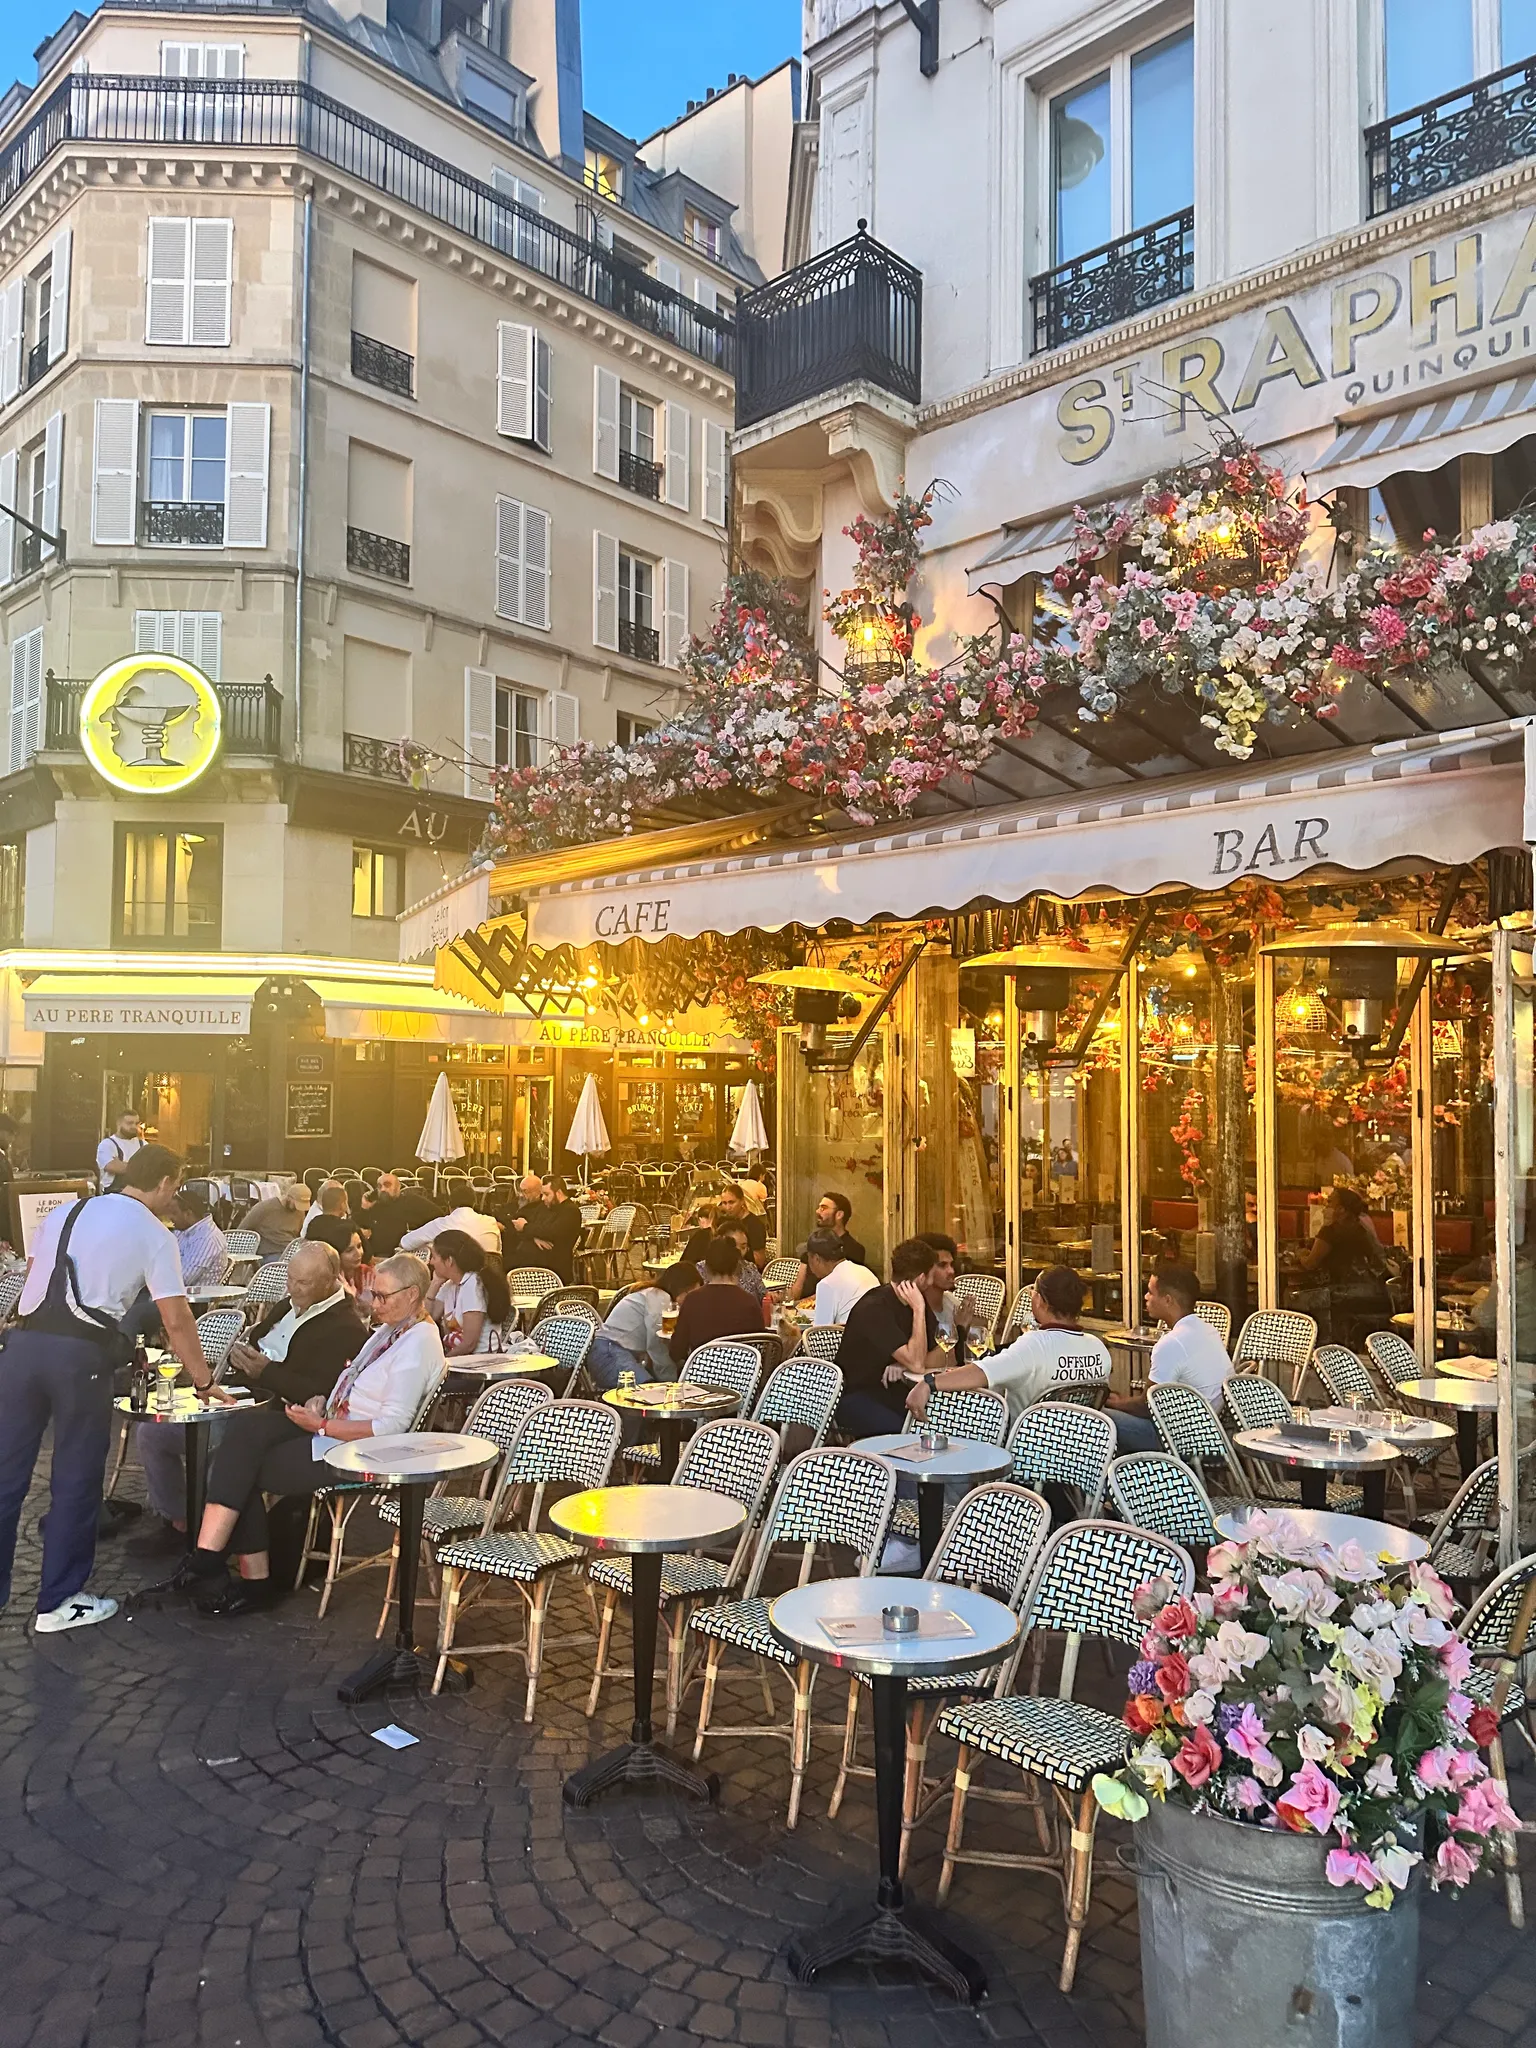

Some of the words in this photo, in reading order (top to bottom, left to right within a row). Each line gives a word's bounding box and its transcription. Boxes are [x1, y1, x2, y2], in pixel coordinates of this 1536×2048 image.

[397, 808, 450, 840] AU
[1209, 817, 1330, 875] BAR
[595, 899, 672, 938] CAFE
[33, 1009, 59, 1024] AU
[65, 1009, 115, 1025] PERE
[120, 1010, 242, 1026] TRANQUILLE
[539, 1025, 563, 1040] AU
[570, 1026, 611, 1043] PERE
[461, 1102, 485, 1115] PERE
[627, 1103, 656, 1115] BRUNCH
[1058, 1354, 1103, 1369] OFFSIDE
[1051, 1366, 1106, 1381] JOURNAL
